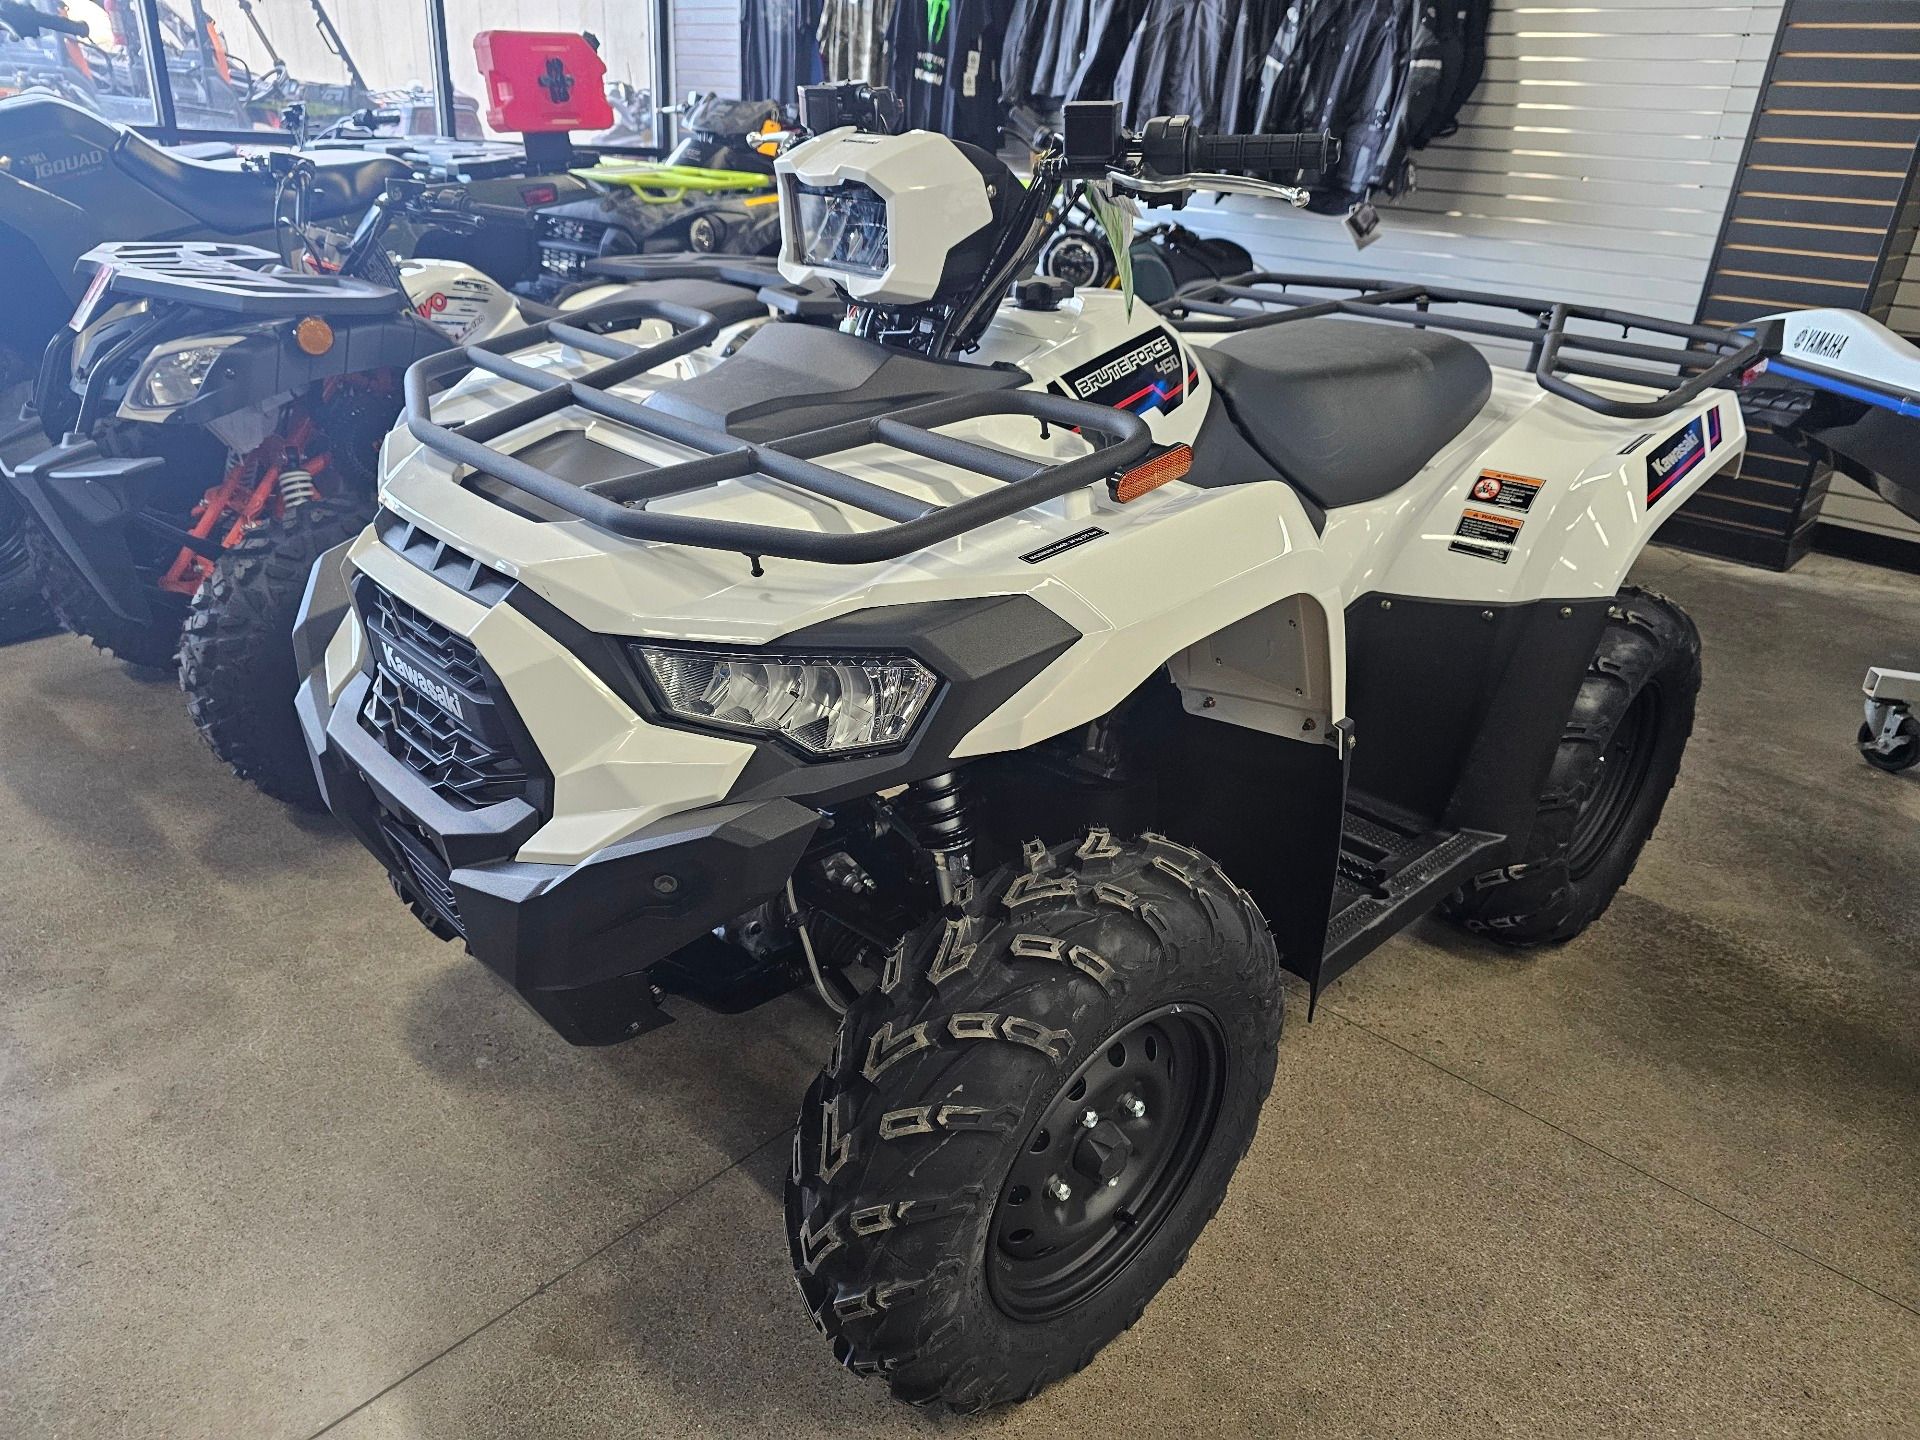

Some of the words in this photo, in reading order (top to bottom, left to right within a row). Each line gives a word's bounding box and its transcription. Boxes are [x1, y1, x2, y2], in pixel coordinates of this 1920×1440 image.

[1802, 328, 1850, 360] YAMAHA
[1154, 353, 1181, 375] 450
[1651, 429, 1700, 477] Kawasaki
[1481, 514, 1514, 526] WARNING
[382, 641, 464, 721] Kawasaki
